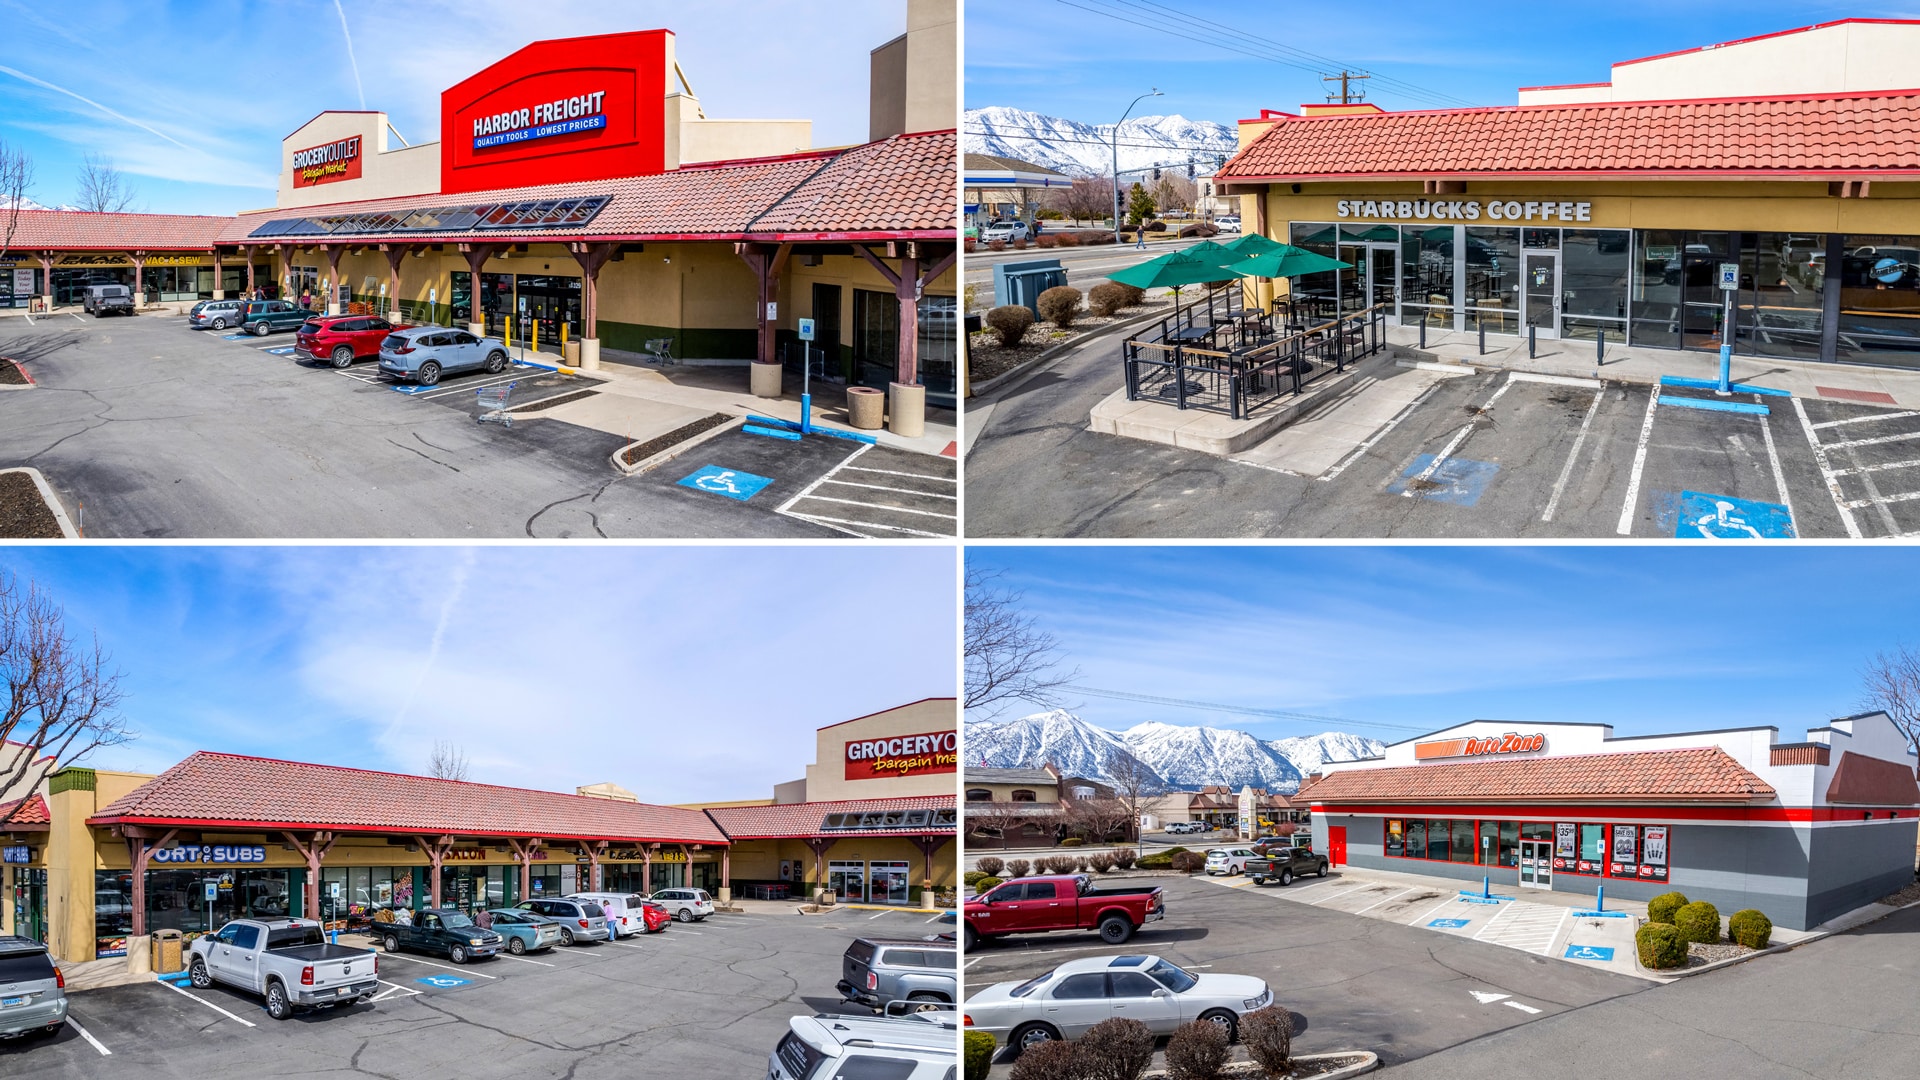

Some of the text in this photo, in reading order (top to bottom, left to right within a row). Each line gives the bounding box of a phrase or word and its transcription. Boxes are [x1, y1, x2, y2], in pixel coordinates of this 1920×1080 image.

[473, 91, 605, 136] HARBOR FREIGHT
[477, 118, 600, 147] QUALITY TOOLS LOWEST PRICES
[1337, 200, 1592, 222] STARBUCKS COFFEE
[145, 256, 201, 265] VAC & SEW
[1464, 732, 1544, 756] AutoZone
[873, 755, 932, 774] bargain
[214, 847, 265, 861] SUBS
